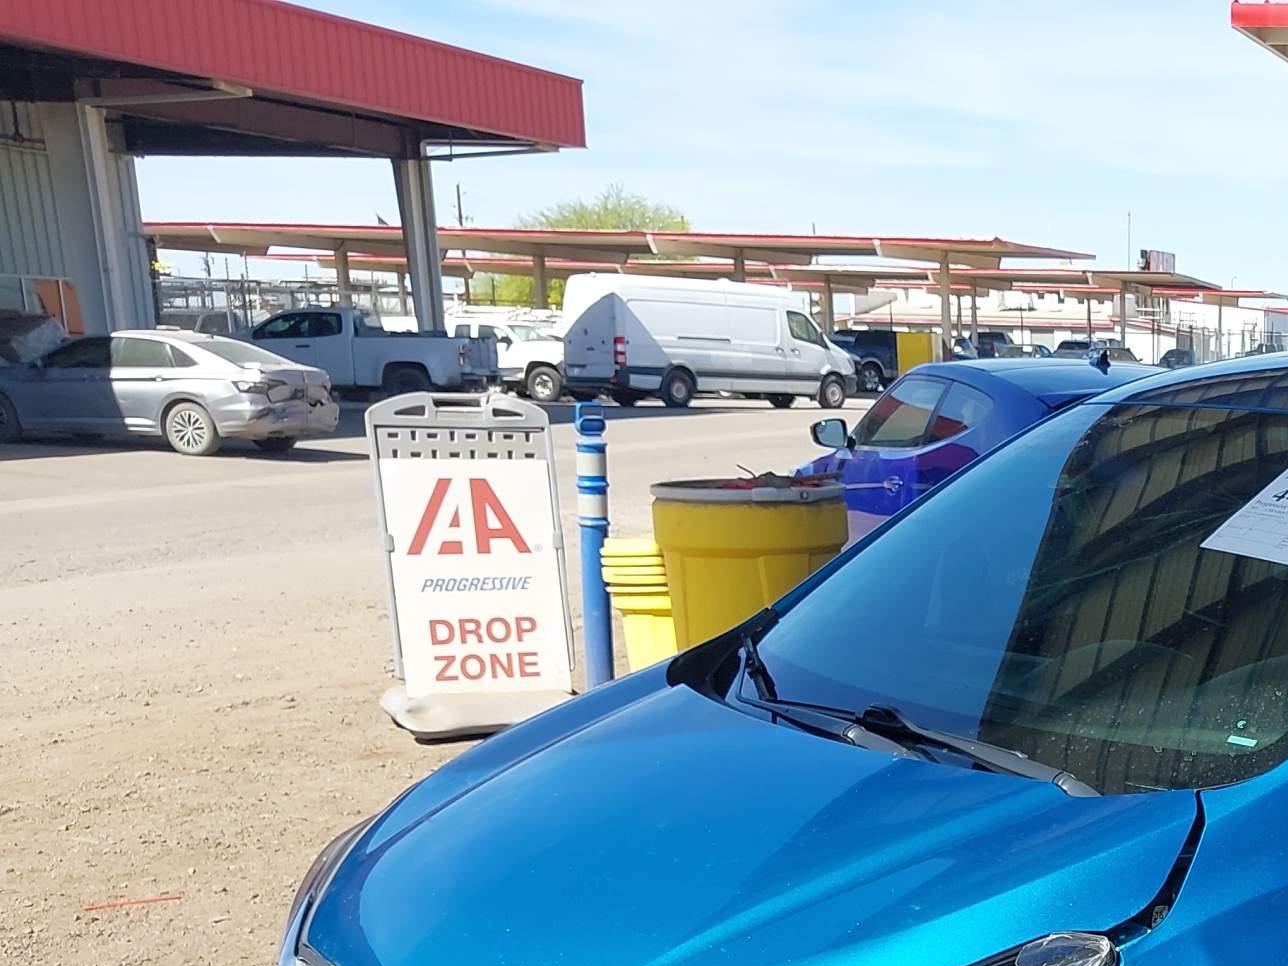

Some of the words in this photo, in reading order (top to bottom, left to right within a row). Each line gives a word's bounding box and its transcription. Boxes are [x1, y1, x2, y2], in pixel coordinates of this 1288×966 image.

[421, 576, 532, 593] PROGRESSIVE
[429, 616, 538, 646] DROP
[433, 652, 541, 682] ZONE
